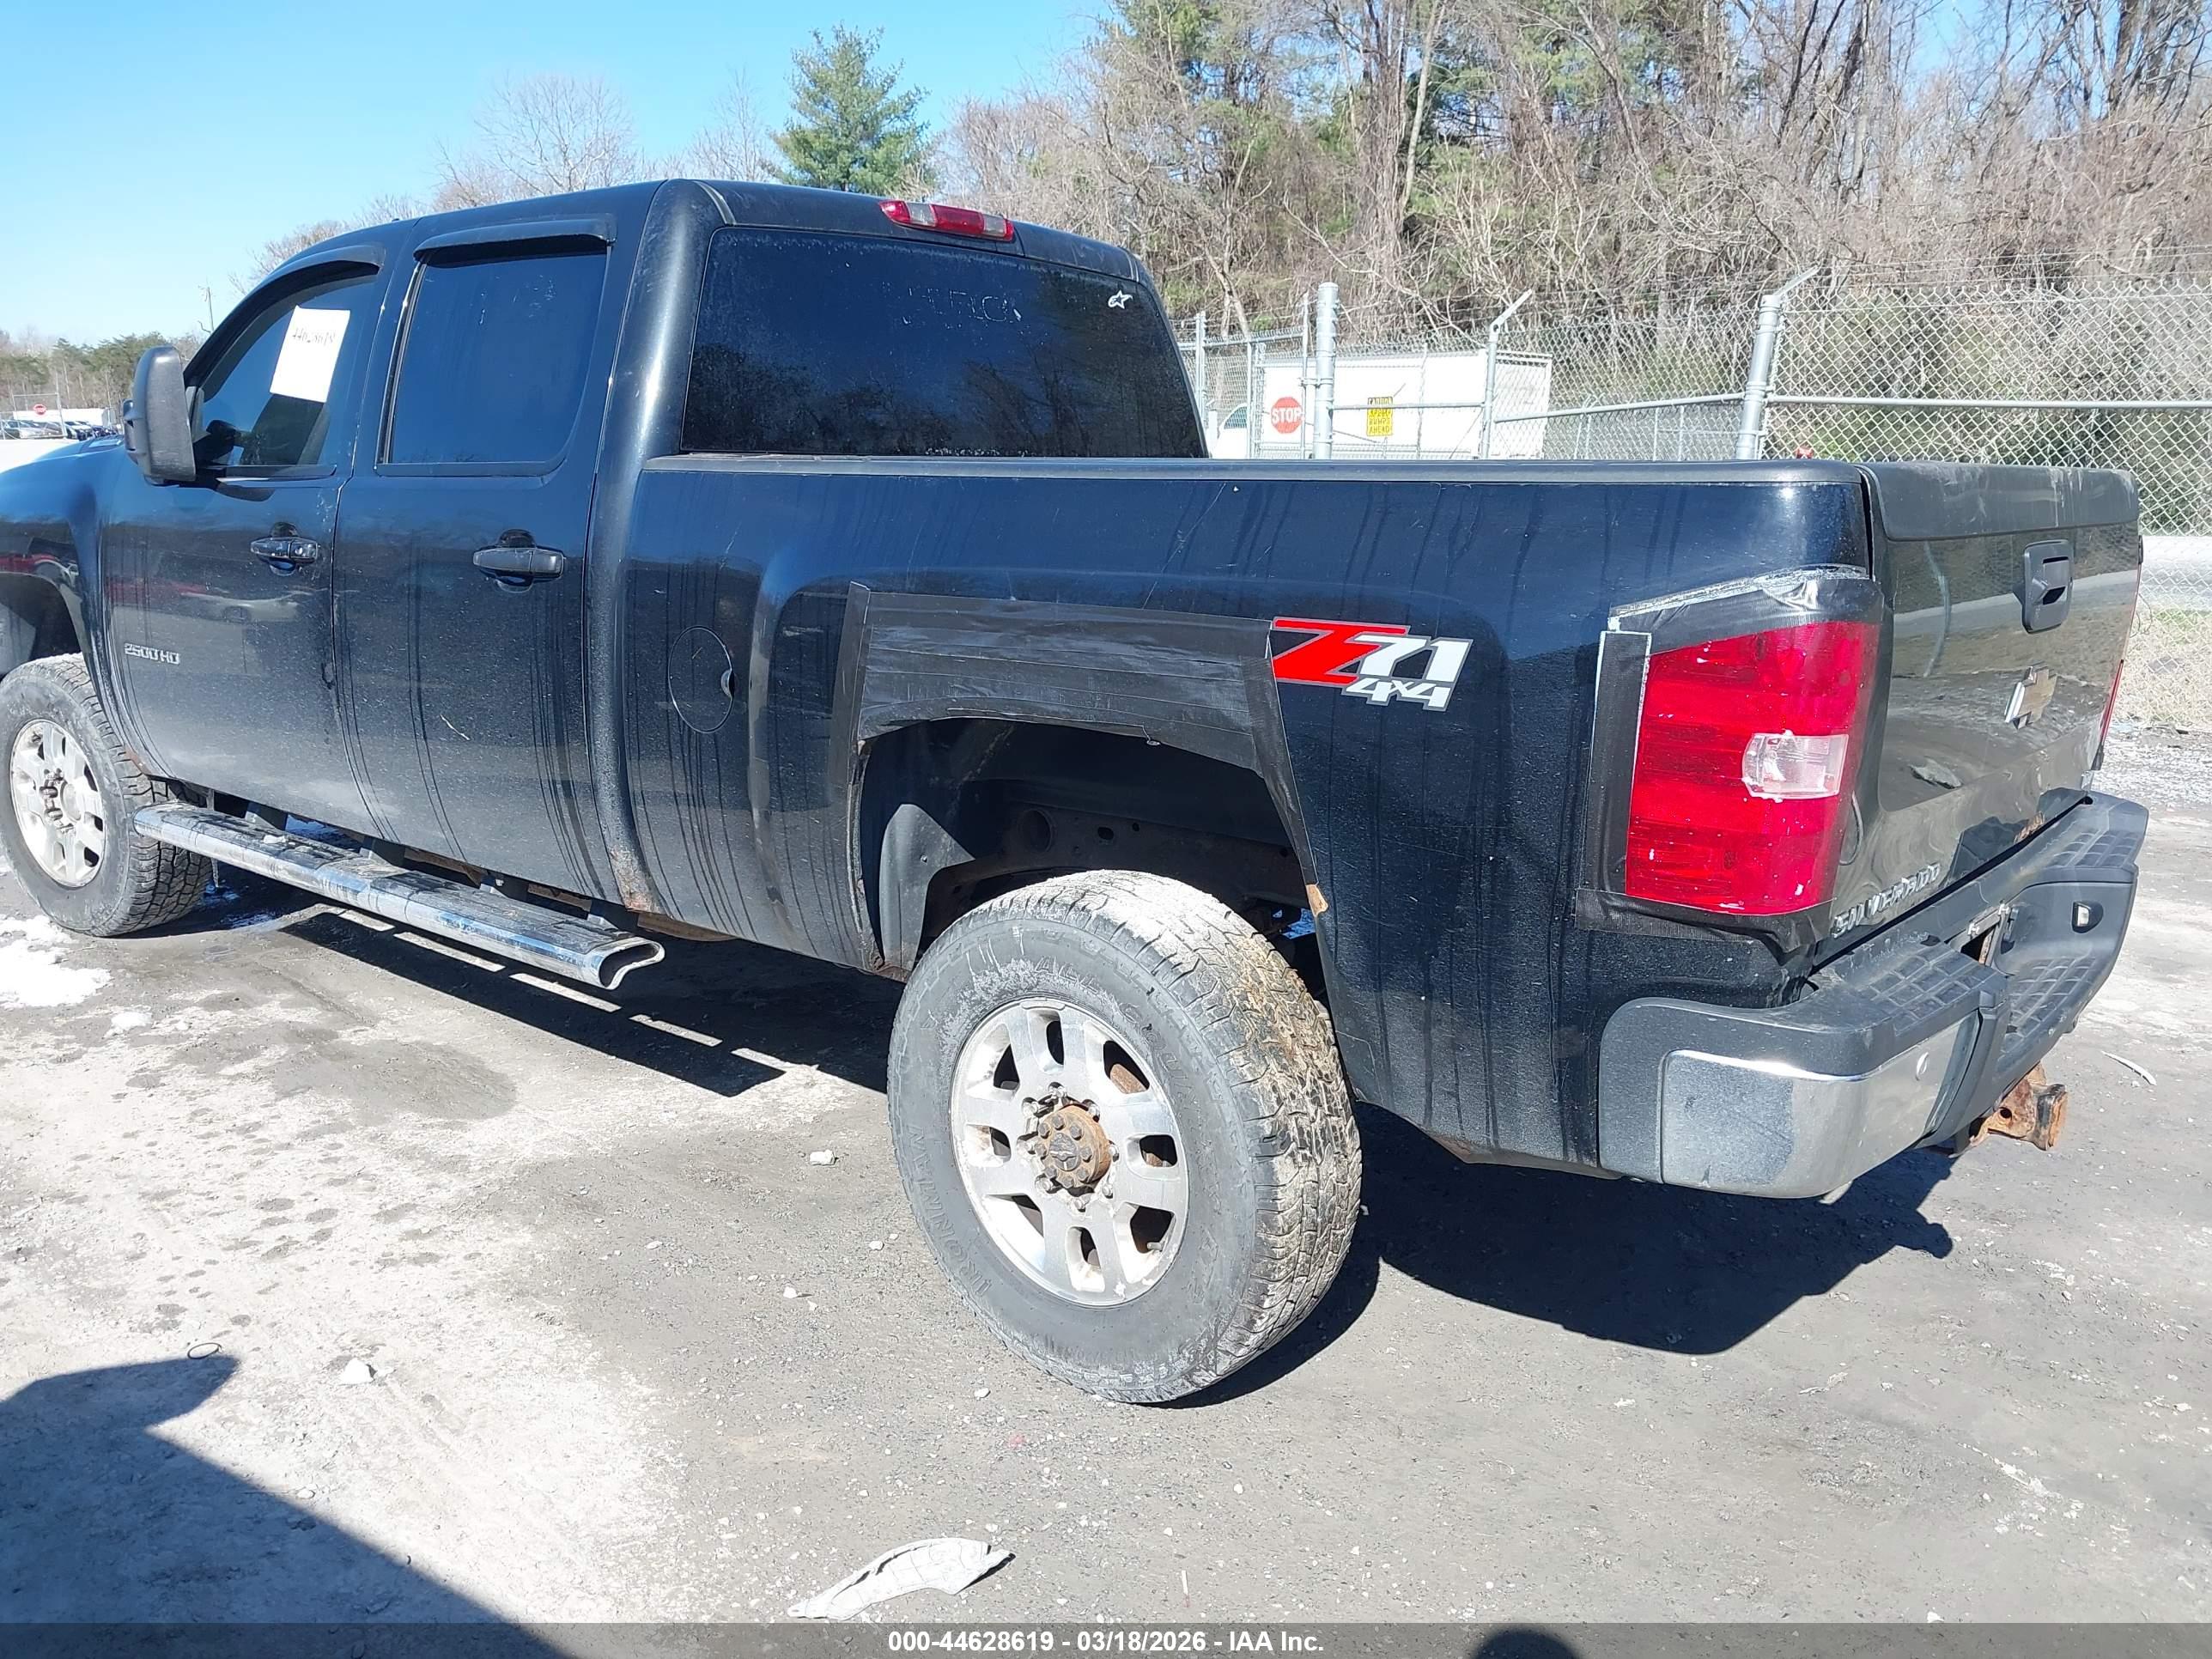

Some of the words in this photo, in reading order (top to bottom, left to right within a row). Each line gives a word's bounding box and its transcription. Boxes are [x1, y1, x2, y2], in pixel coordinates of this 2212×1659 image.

[1272, 408, 1303, 422] STOP
[125, 642, 159, 660] 2500
[160, 650, 179, 665] HD
[1273, 617, 1474, 685] Z71
[1831, 863, 1940, 939] SILVERADO
[906, 1124, 992, 1296] IRONMAN
